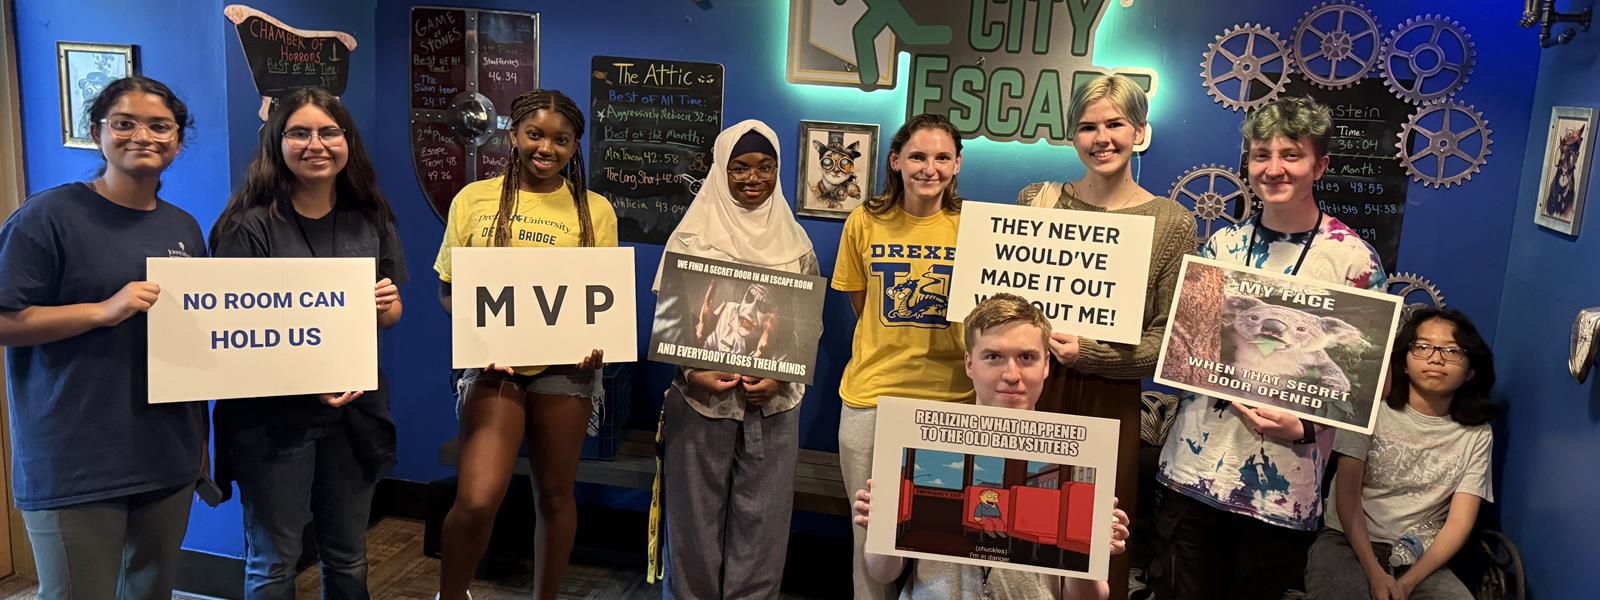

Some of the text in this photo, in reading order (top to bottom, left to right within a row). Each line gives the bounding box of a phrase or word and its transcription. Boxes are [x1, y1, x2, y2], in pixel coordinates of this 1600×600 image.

[250, 19, 326, 50] CHAMBER OF
[415, 11, 455, 37] GAME
[968, 0, 1104, 57] CITY
[420, 27, 461, 54] STONES
[488, 71, 517, 84] 46:34
[612, 63, 693, 86] The Attic
[911, 54, 1151, 145] ESCA
[416, 126, 432, 141] 2nd
[666, 129, 705, 145] Month:
[1336, 125, 1365, 136] Time:
[421, 146, 448, 157] Escape
[1338, 139, 1378, 150] 36:04
[643, 152, 679, 164] 42:58
[1325, 162, 1382, 175] he Month:
[604, 166, 619, 182] The
[620, 166, 637, 190] Long
[1350, 181, 1384, 195] 48:55
[1364, 203, 1397, 216] 54:38
[523, 215, 572, 234] University
[990, 216, 1121, 245] THEY NEVER
[518, 229, 557, 245] BRIDGE
[870, 244, 957, 261] DREXE
[995, 243, 1109, 271] WOULD'VE
[677, 259, 814, 291] WE FIND A SECRET DOOR IN AN ESCAPE ROOM
[980, 268, 1117, 298] MADE IT OUT
[183, 290, 345, 311] NO ROOM CAN
[476, 284, 615, 328] MVP
[1239, 281, 1336, 311] MY FACE
[1078, 305, 1117, 327] ME!
[211, 327, 322, 350] HOLD US
[656, 342, 807, 376] AND EVERYBODY LOSES THEIR MINDS
[1188, 356, 1351, 402] WHEN THAT SECRET
[1207, 373, 1323, 409] DOOR OPENED
[915, 409, 1087, 441] REALIZING WHAT HAPPENED
[920, 425, 1079, 457] TO THE OLD BABYSITTERS
[975, 545, 1008, 555] (chuckles)
